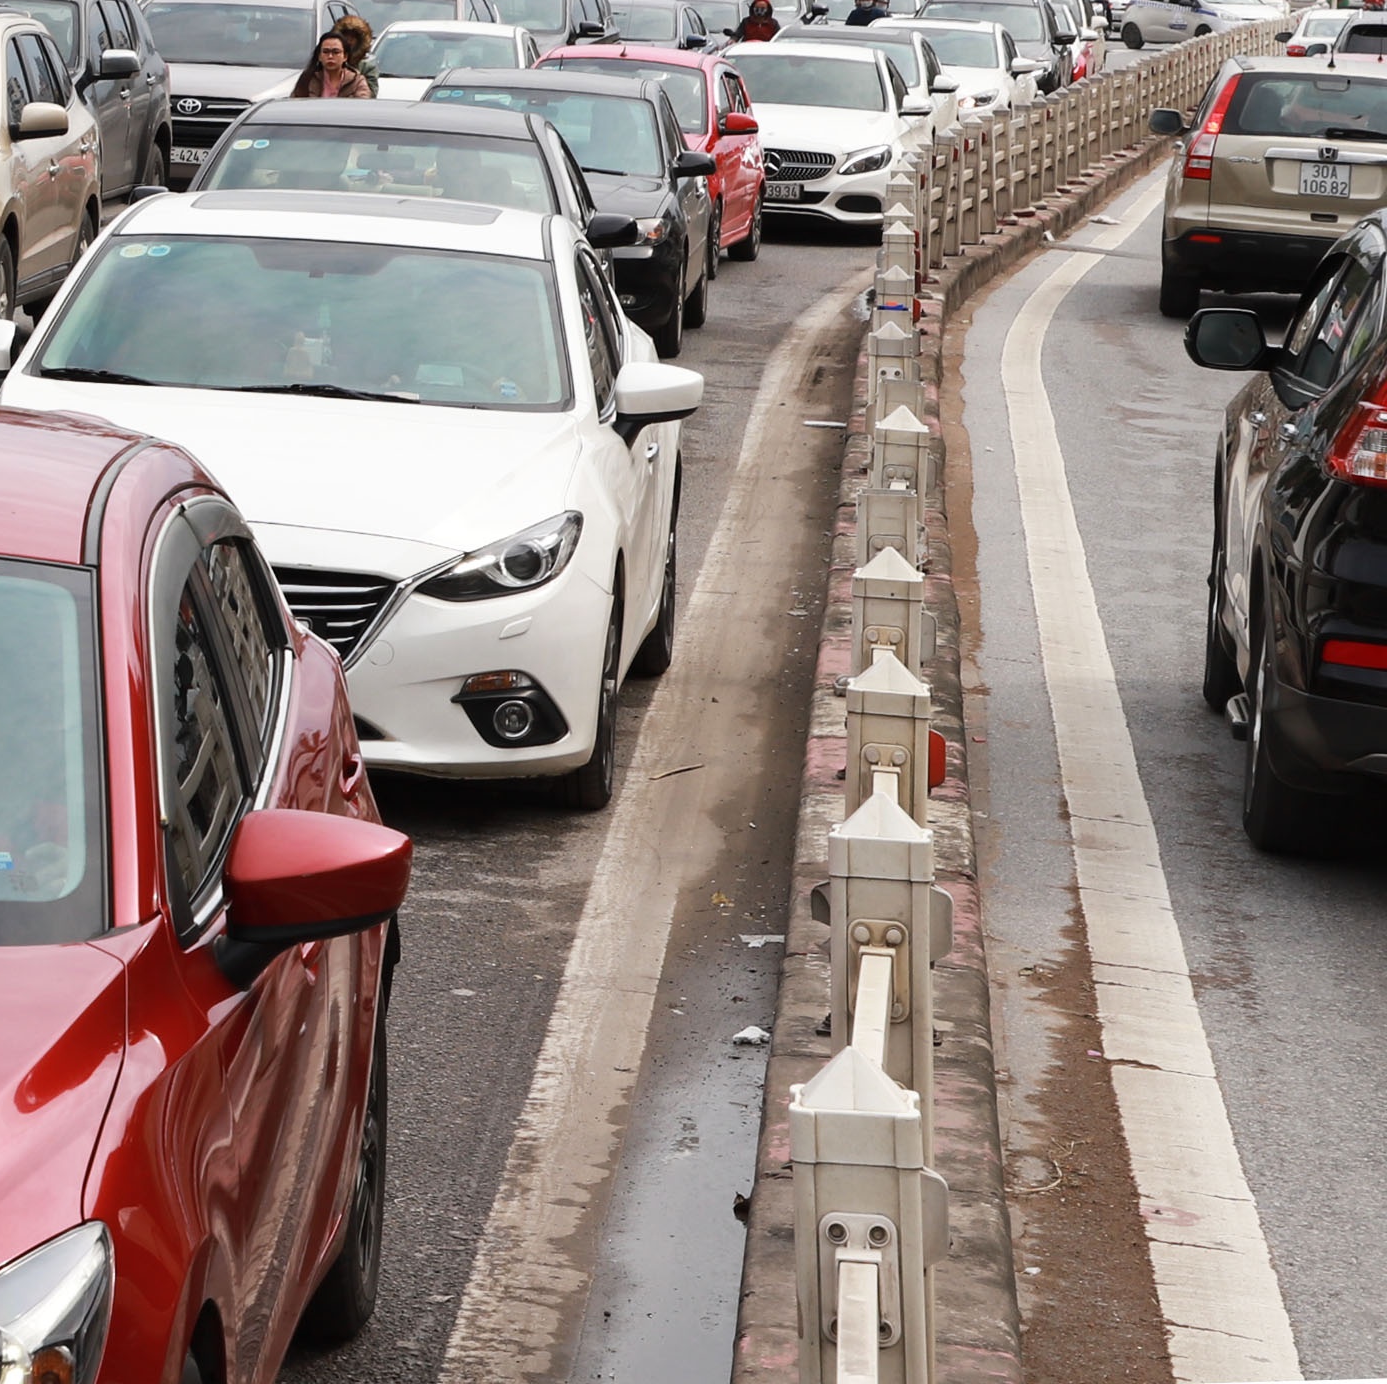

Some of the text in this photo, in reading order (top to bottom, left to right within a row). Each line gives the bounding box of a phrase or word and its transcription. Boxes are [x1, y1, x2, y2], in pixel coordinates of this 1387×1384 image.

[1312, 165, 1338, 180] 30A
[764, 184, 797, 198] 39.34
[1302, 179, 1348, 196] 106.82
